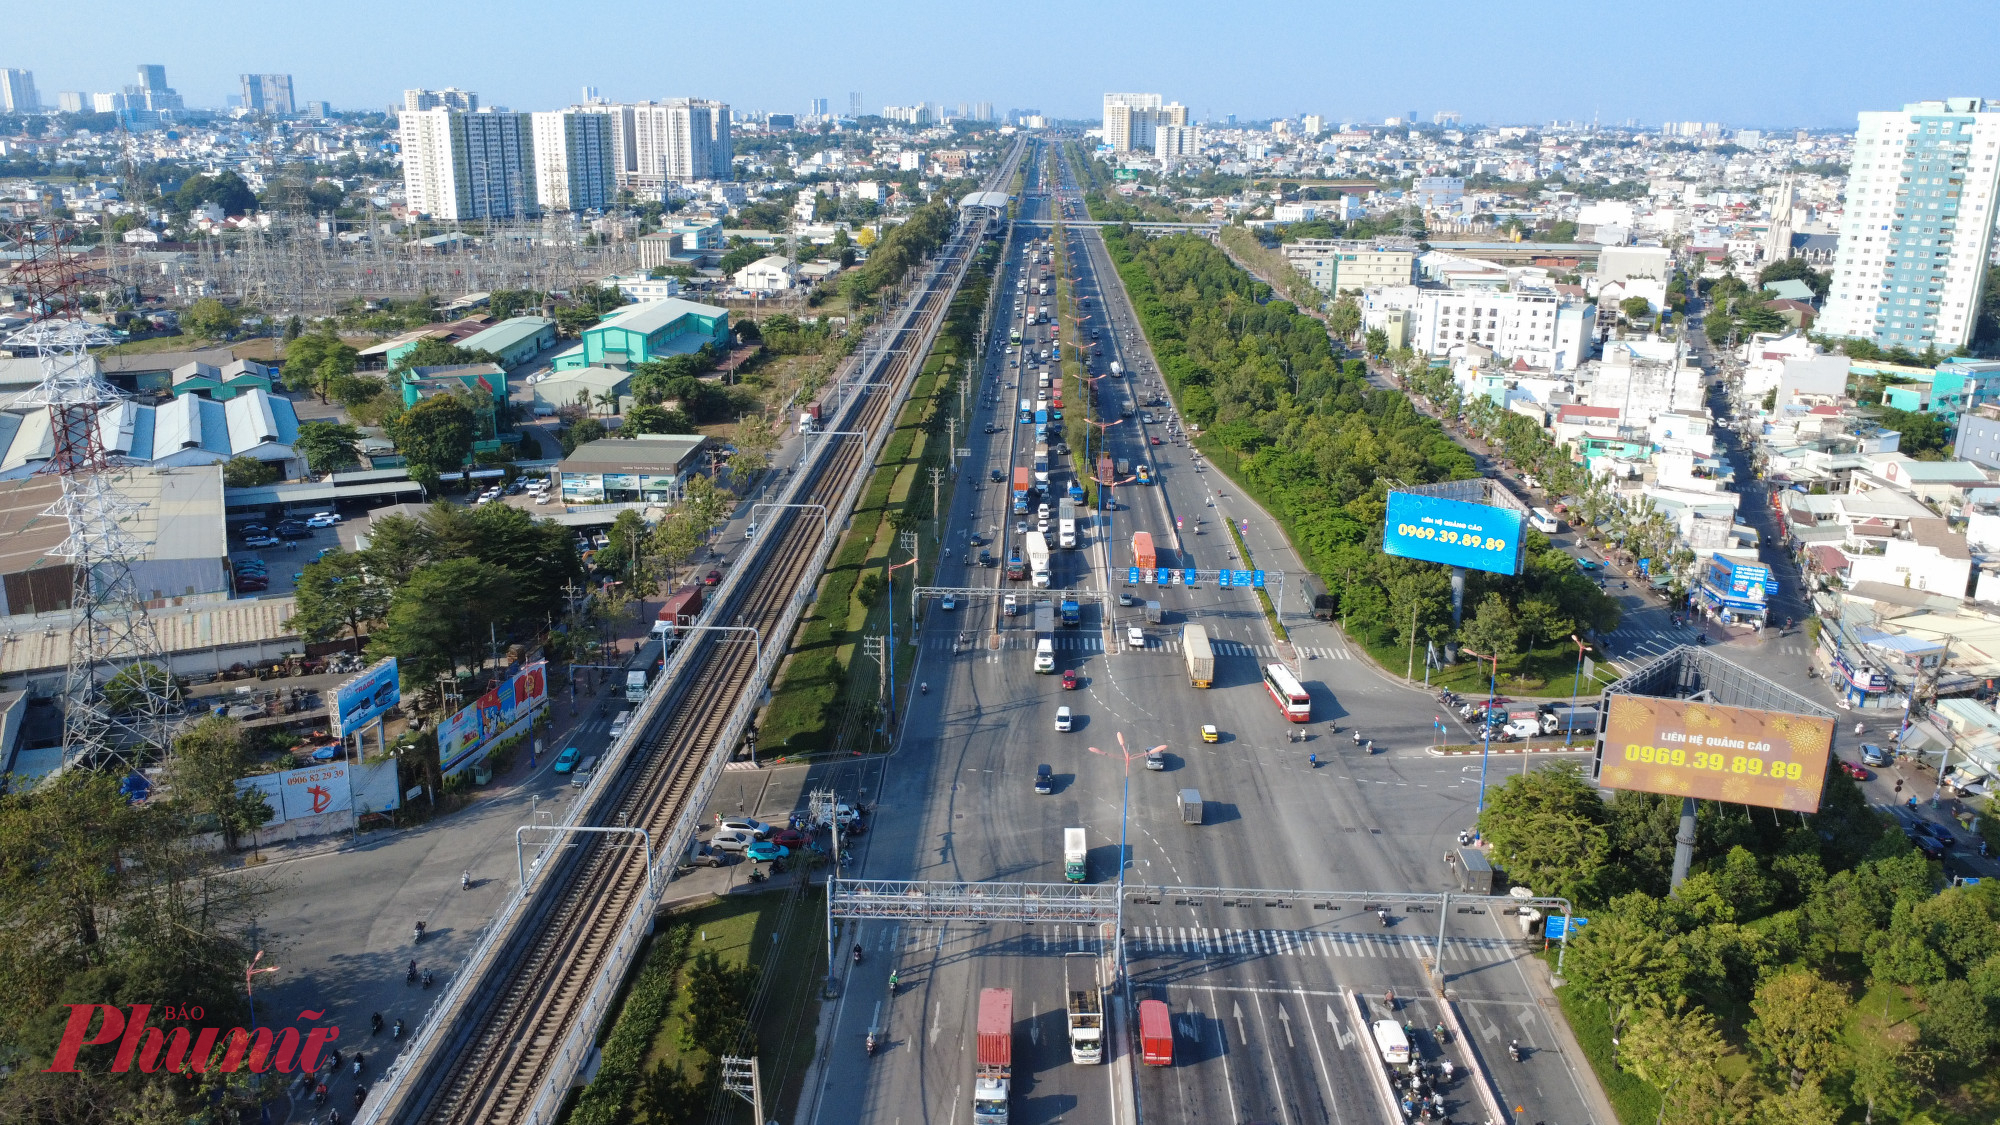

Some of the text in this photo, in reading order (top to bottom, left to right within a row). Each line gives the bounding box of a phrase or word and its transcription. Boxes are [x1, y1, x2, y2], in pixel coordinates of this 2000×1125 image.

[1435, 518, 1443, 526] HỆ
[1444, 520, 1466, 529] QUẢNG
[1468, 523, 1482, 531] CÁO
[1398, 523, 1505, 551] 0969.39.89.89
[1661, 732, 1770, 752] LIÊN HỆ QUẢNG CÁO
[1625, 744, 1803, 780] 0969.39.89.89
[287, 776, 308, 786] 0906
[309, 773, 319, 782] 82
[322, 771, 332, 780] 29
[334, 769, 344, 779] 39
